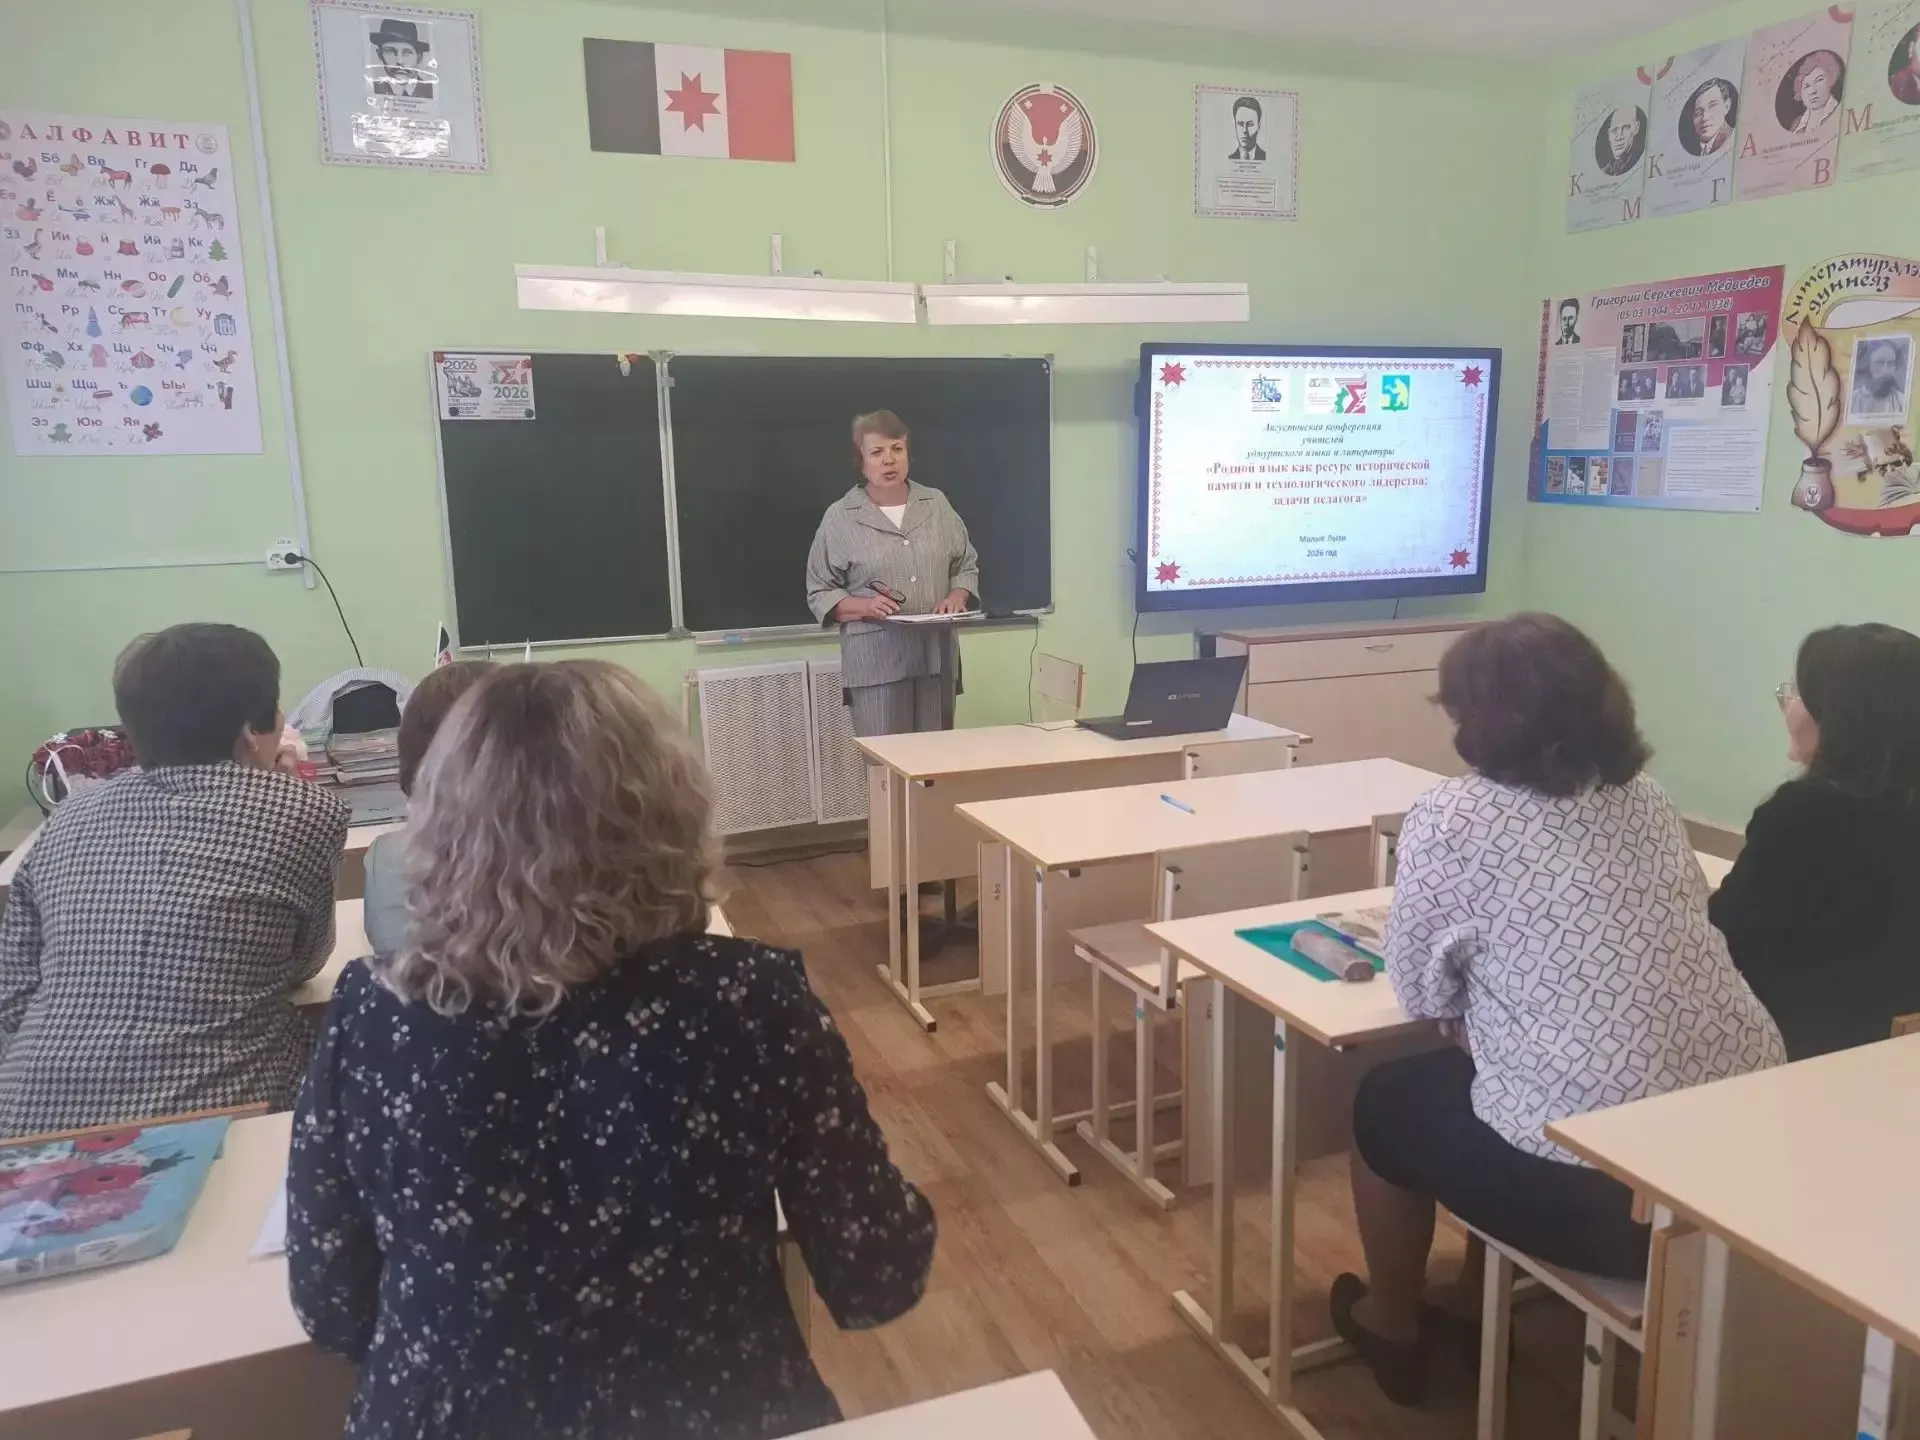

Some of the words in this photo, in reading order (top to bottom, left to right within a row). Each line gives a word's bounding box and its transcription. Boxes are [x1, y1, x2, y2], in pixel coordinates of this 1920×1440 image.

[1844, 103, 1875, 136] М
[20, 123, 189, 150] АЛФАВИТ
[1739, 133, 1758, 159] А
[40, 152, 60, 163] Бб
[135, 159, 149, 169] Гг
[179, 161, 198, 173] Дд
[1648, 153, 1665, 179] К
[1812, 158, 1831, 185] В
[1570, 173, 1584, 197] К
[1710, 177, 1726, 203] Г
[94, 195, 116, 206] Жж
[1622, 196, 1642, 221] М
[51, 231, 70, 241] Ии
[188, 237, 203, 247] Кк
[56, 268, 79, 279] Мм
[103, 270, 122, 281] Нн
[148, 271, 167, 282] Оо
[1643, 284, 1703, 303] Сергеевич
[1706, 275, 1770, 294] Медведев
[61, 304, 80, 316] Рр
[152, 306, 167, 317] Тт
[20, 341, 45, 353] Фф
[156, 343, 174, 353] Чч
[445, 360, 477, 371] 2026
[25, 379, 52, 389] Шш
[493, 386, 529, 399] 2026
[76, 417, 103, 427] Юю
[1300, 435, 1344, 446] учителей
[1259, 464, 1288, 473] язык
[1291, 463, 1313, 472] как
[1315, 462, 1352, 475] ресурс
[1355, 459, 1430, 474] исторической
[1207, 481, 1251, 491] памяти
[1266, 478, 1366, 489] технологического
[1272, 497, 1310, 506] задачи
[1313, 495, 1367, 504] педагога»
[1299, 535, 1325, 543] Малые
[1306, 549, 1324, 557] 2026
[1325, 549, 1337, 558] год
